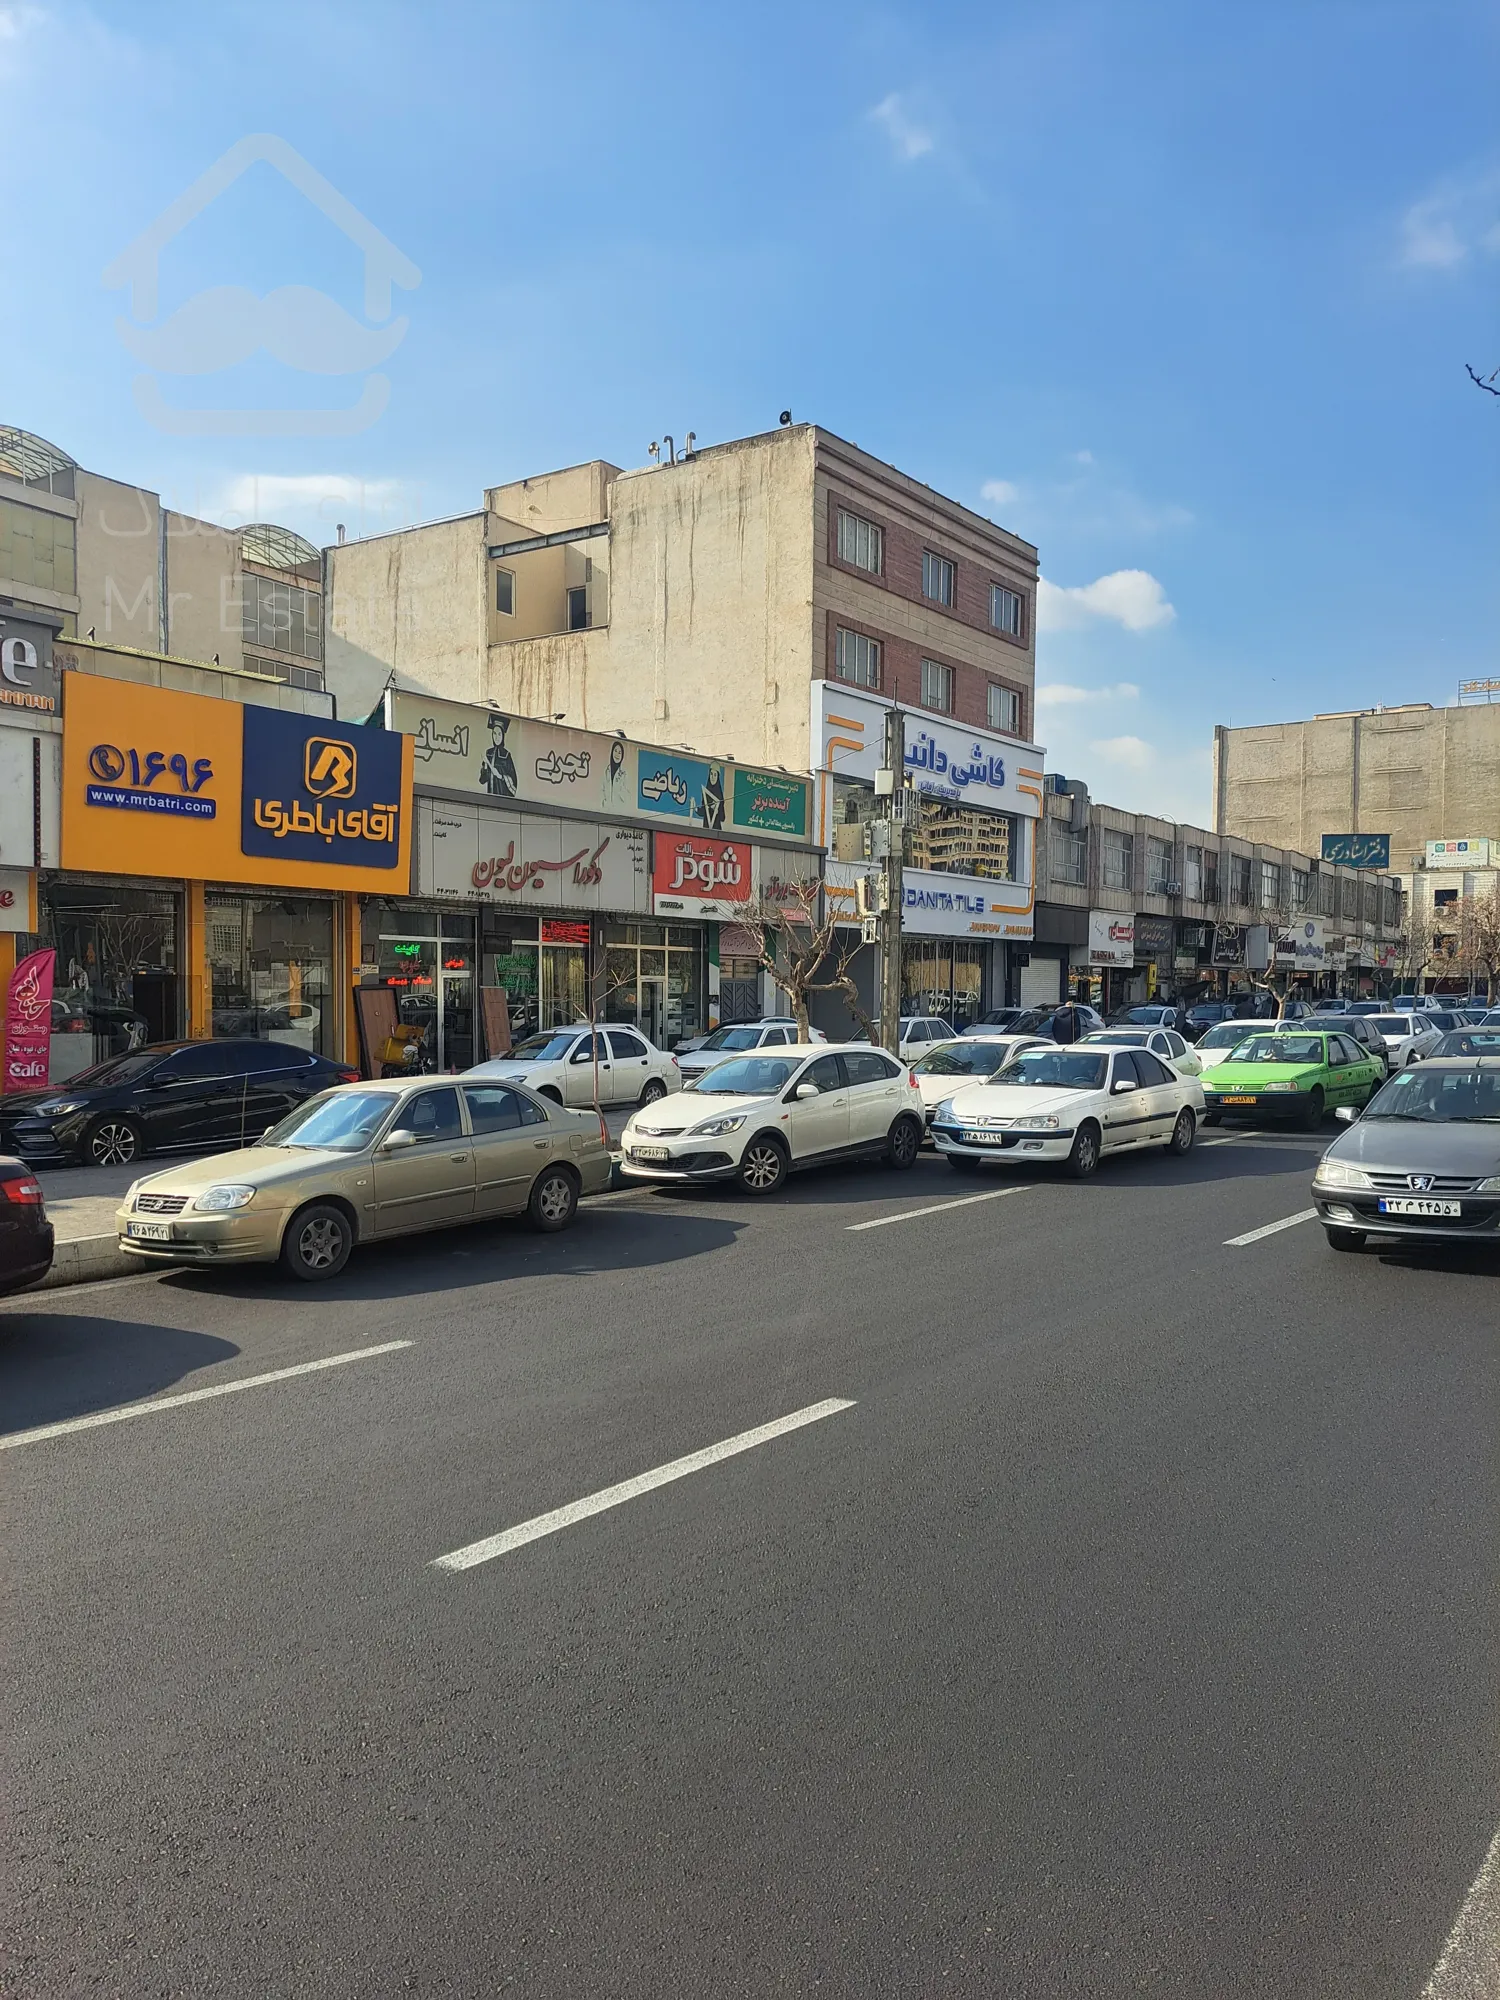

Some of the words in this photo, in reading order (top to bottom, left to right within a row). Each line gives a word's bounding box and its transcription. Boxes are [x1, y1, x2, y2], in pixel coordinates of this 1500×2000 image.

[903, 732, 947, 777] دانی
[950, 743, 1005, 787] کاشی
[129, 748, 214, 793] ۱۶۹۶
[535, 750, 591, 784] تجربی
[641, 768, 687, 804] ریاضی
[746, 774, 766, 786] دخترانه
[91, 789, 212, 813] www.mrbatri.com
[769, 797, 791, 814] آینده
[254, 799, 336, 843] باطری
[338, 803, 398, 842] آقای
[615, 829, 631, 840] دیواری
[675, 841, 714, 857] شیرآلات
[1324, 841, 1344, 862] رسمی
[1362, 838, 1386, 862] دفتر
[507, 837, 610, 890] دکوراسیون
[669, 846, 742, 892] شودر
[906, 889, 952, 911] DANITA
[956, 895, 985, 914] TILE
[11, 1022, 48, 1034] رستوران
[9, 1060, 46, 1077] Cafe
[1387, 1200, 1402, 1211] ۳۳
[1405, 1201, 1414, 1212] م
[1418, 1201, 1441, 1214] ۴۴۵
[1443, 1205, 1458, 1215] ۵۰
